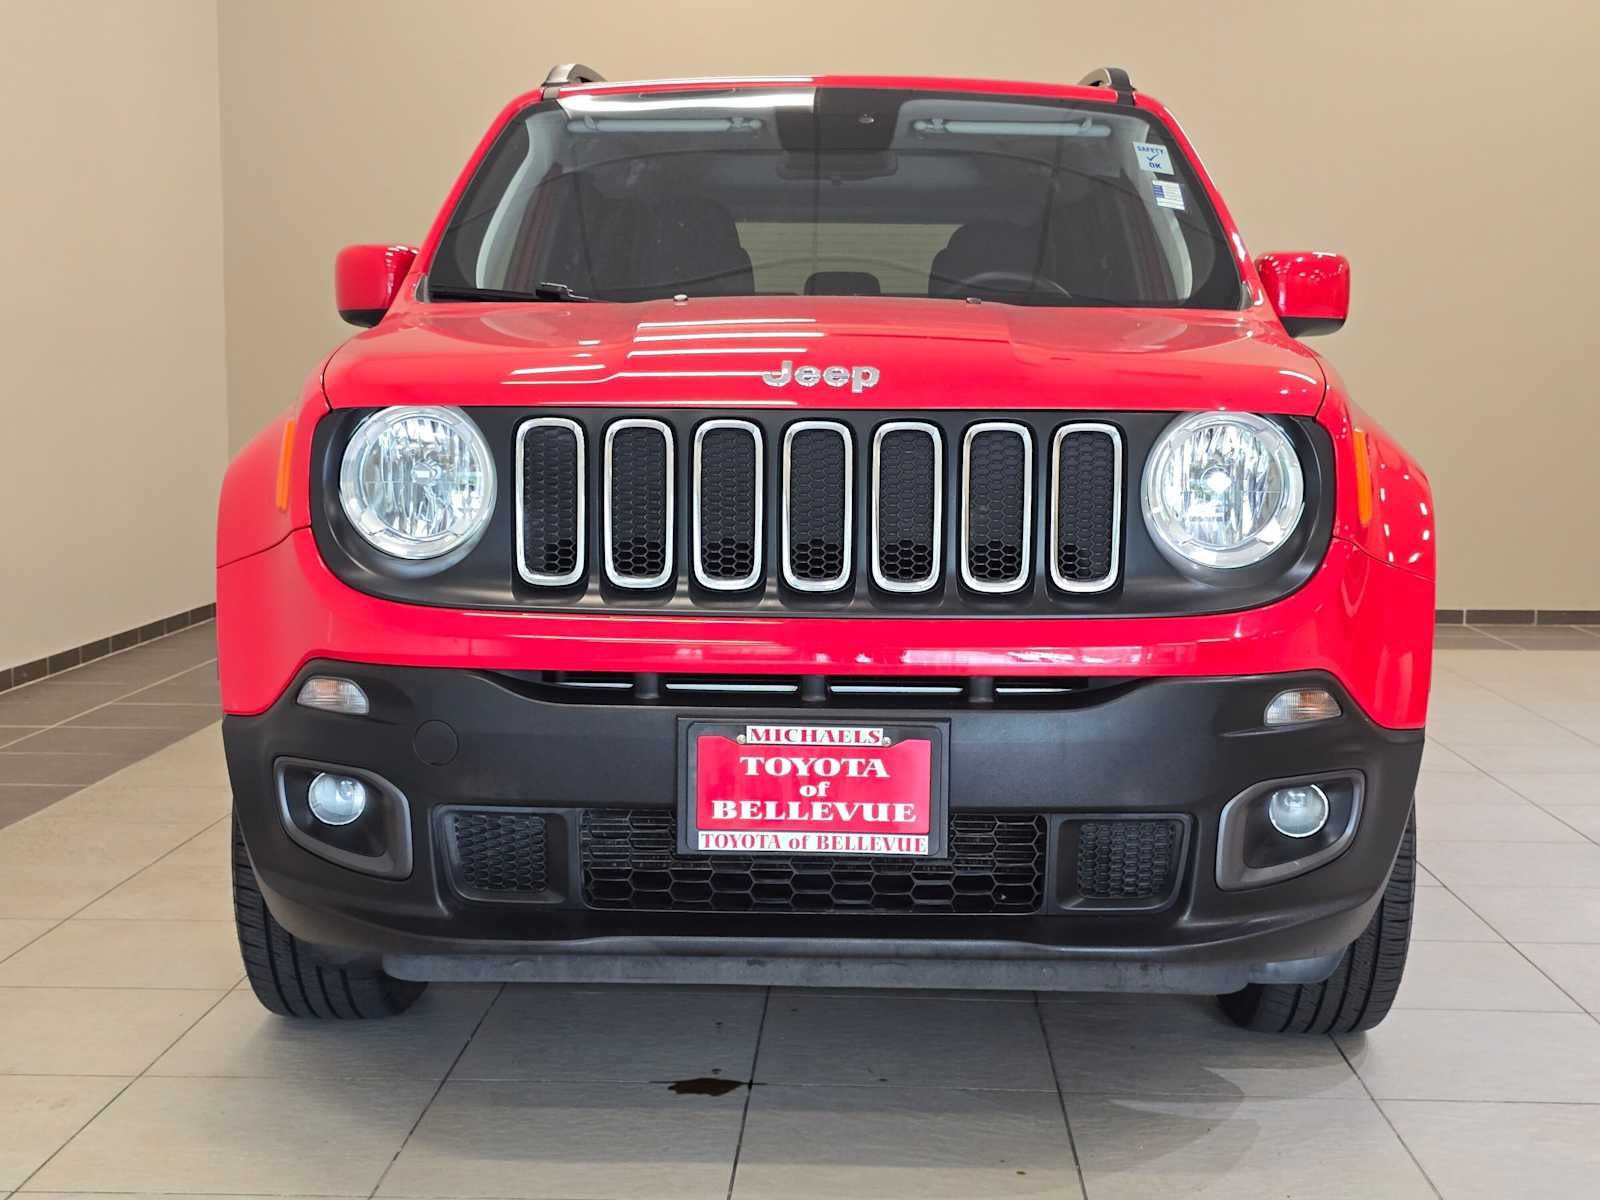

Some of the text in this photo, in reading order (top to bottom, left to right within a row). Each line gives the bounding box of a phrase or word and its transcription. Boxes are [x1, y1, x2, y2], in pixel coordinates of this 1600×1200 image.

[1137, 145, 1164, 155] SAFETY
[762, 360, 880, 393] Jeep
[750, 728, 881, 744] MICHAELS
[739, 756, 890, 778] TOYOTA
[800, 781, 831, 797] of
[711, 800, 917, 822] BELLEVUE
[700, 833, 928, 853] TOYOTA of BELLEVUE
